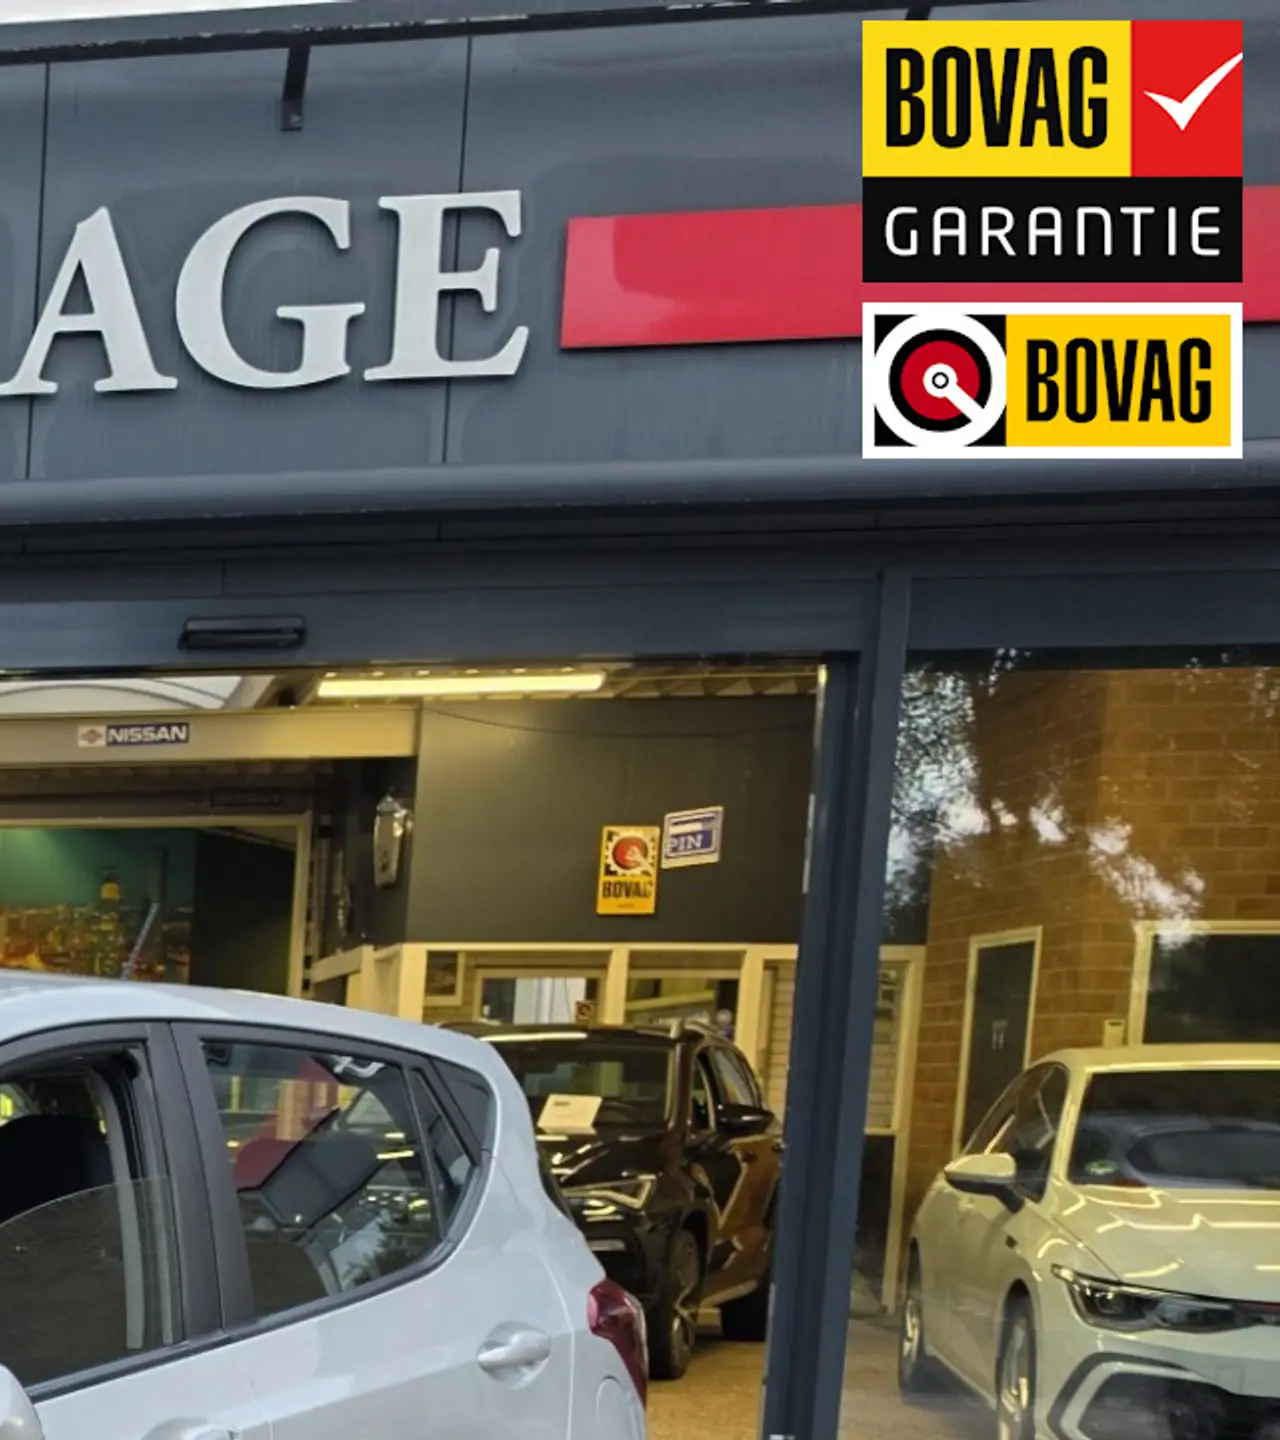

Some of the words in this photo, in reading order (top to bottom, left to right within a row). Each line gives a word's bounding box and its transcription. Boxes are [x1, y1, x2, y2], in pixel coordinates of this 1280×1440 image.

[108, 725, 187, 744] NISSAN
[669, 833, 703, 850] PIN
[603, 879, 653, 898] BOVAG
